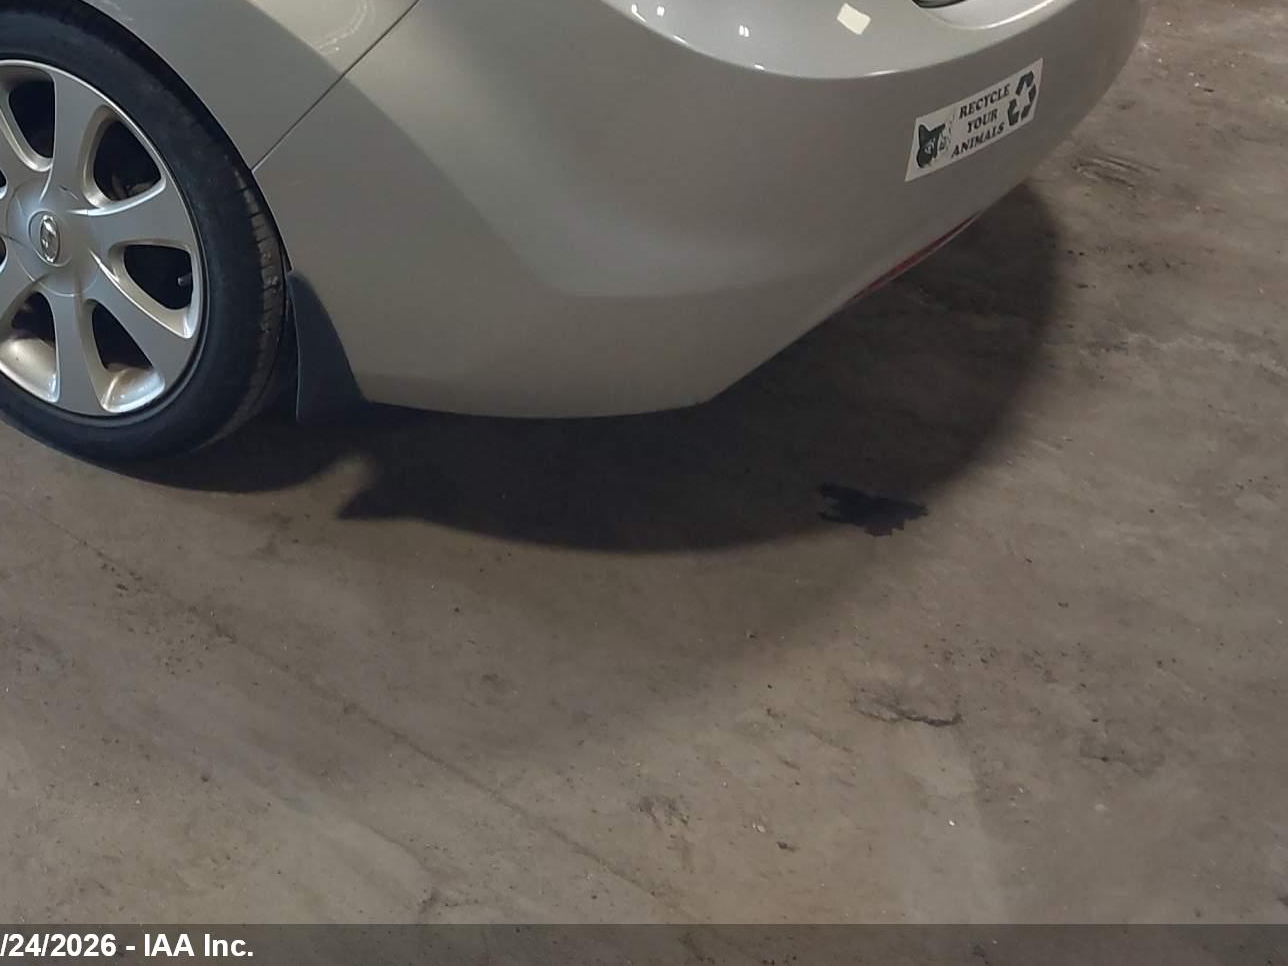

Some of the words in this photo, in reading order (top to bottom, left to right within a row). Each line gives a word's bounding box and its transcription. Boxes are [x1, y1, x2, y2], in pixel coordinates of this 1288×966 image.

[958, 83, 1010, 120] RECYCLE
[967, 108, 998, 134] YOUR
[951, 121, 1005, 159] ANIMALS
